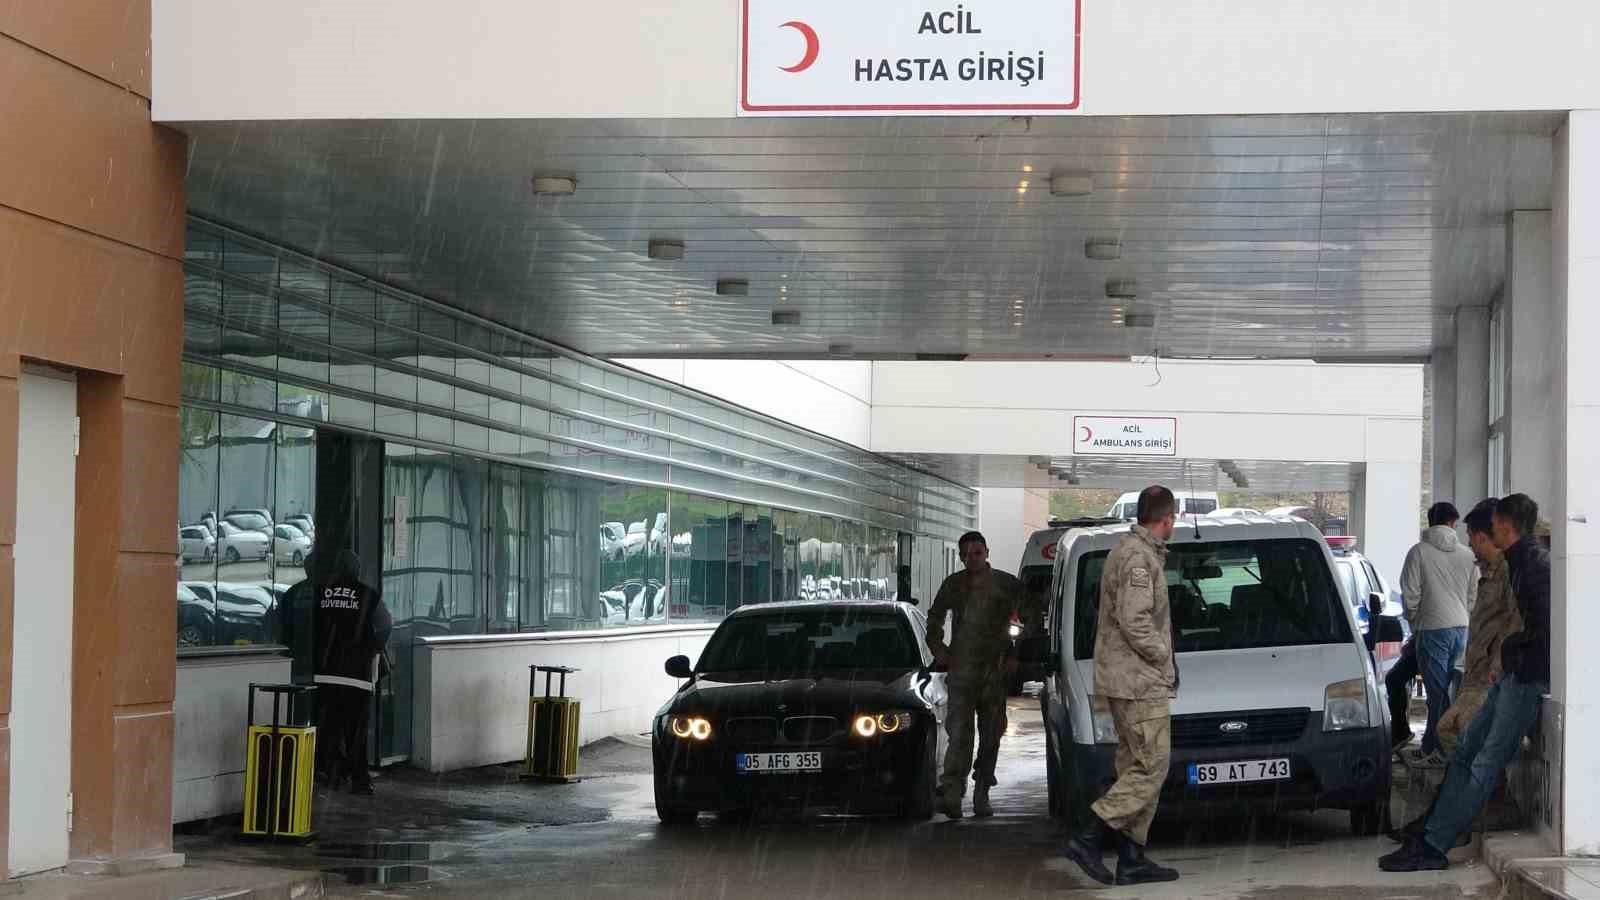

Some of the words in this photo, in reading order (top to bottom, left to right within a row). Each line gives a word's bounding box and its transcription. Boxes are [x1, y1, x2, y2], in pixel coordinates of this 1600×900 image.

[918, 4, 982, 34] ACİL
[855, 59, 949, 81] HASTA
[958, 51, 1044, 87] GİRİŞİ
[1122, 424, 1142, 433] ACİL
[1093, 439, 1143, 447] AMBULANS
[745, 755, 759, 768] 05
[768, 754, 790, 768] AFG
[796, 753, 819, 767] 355
[1199, 766, 1217, 781] 69
[1229, 764, 1247, 780] AT
[1258, 761, 1288, 777] 743
